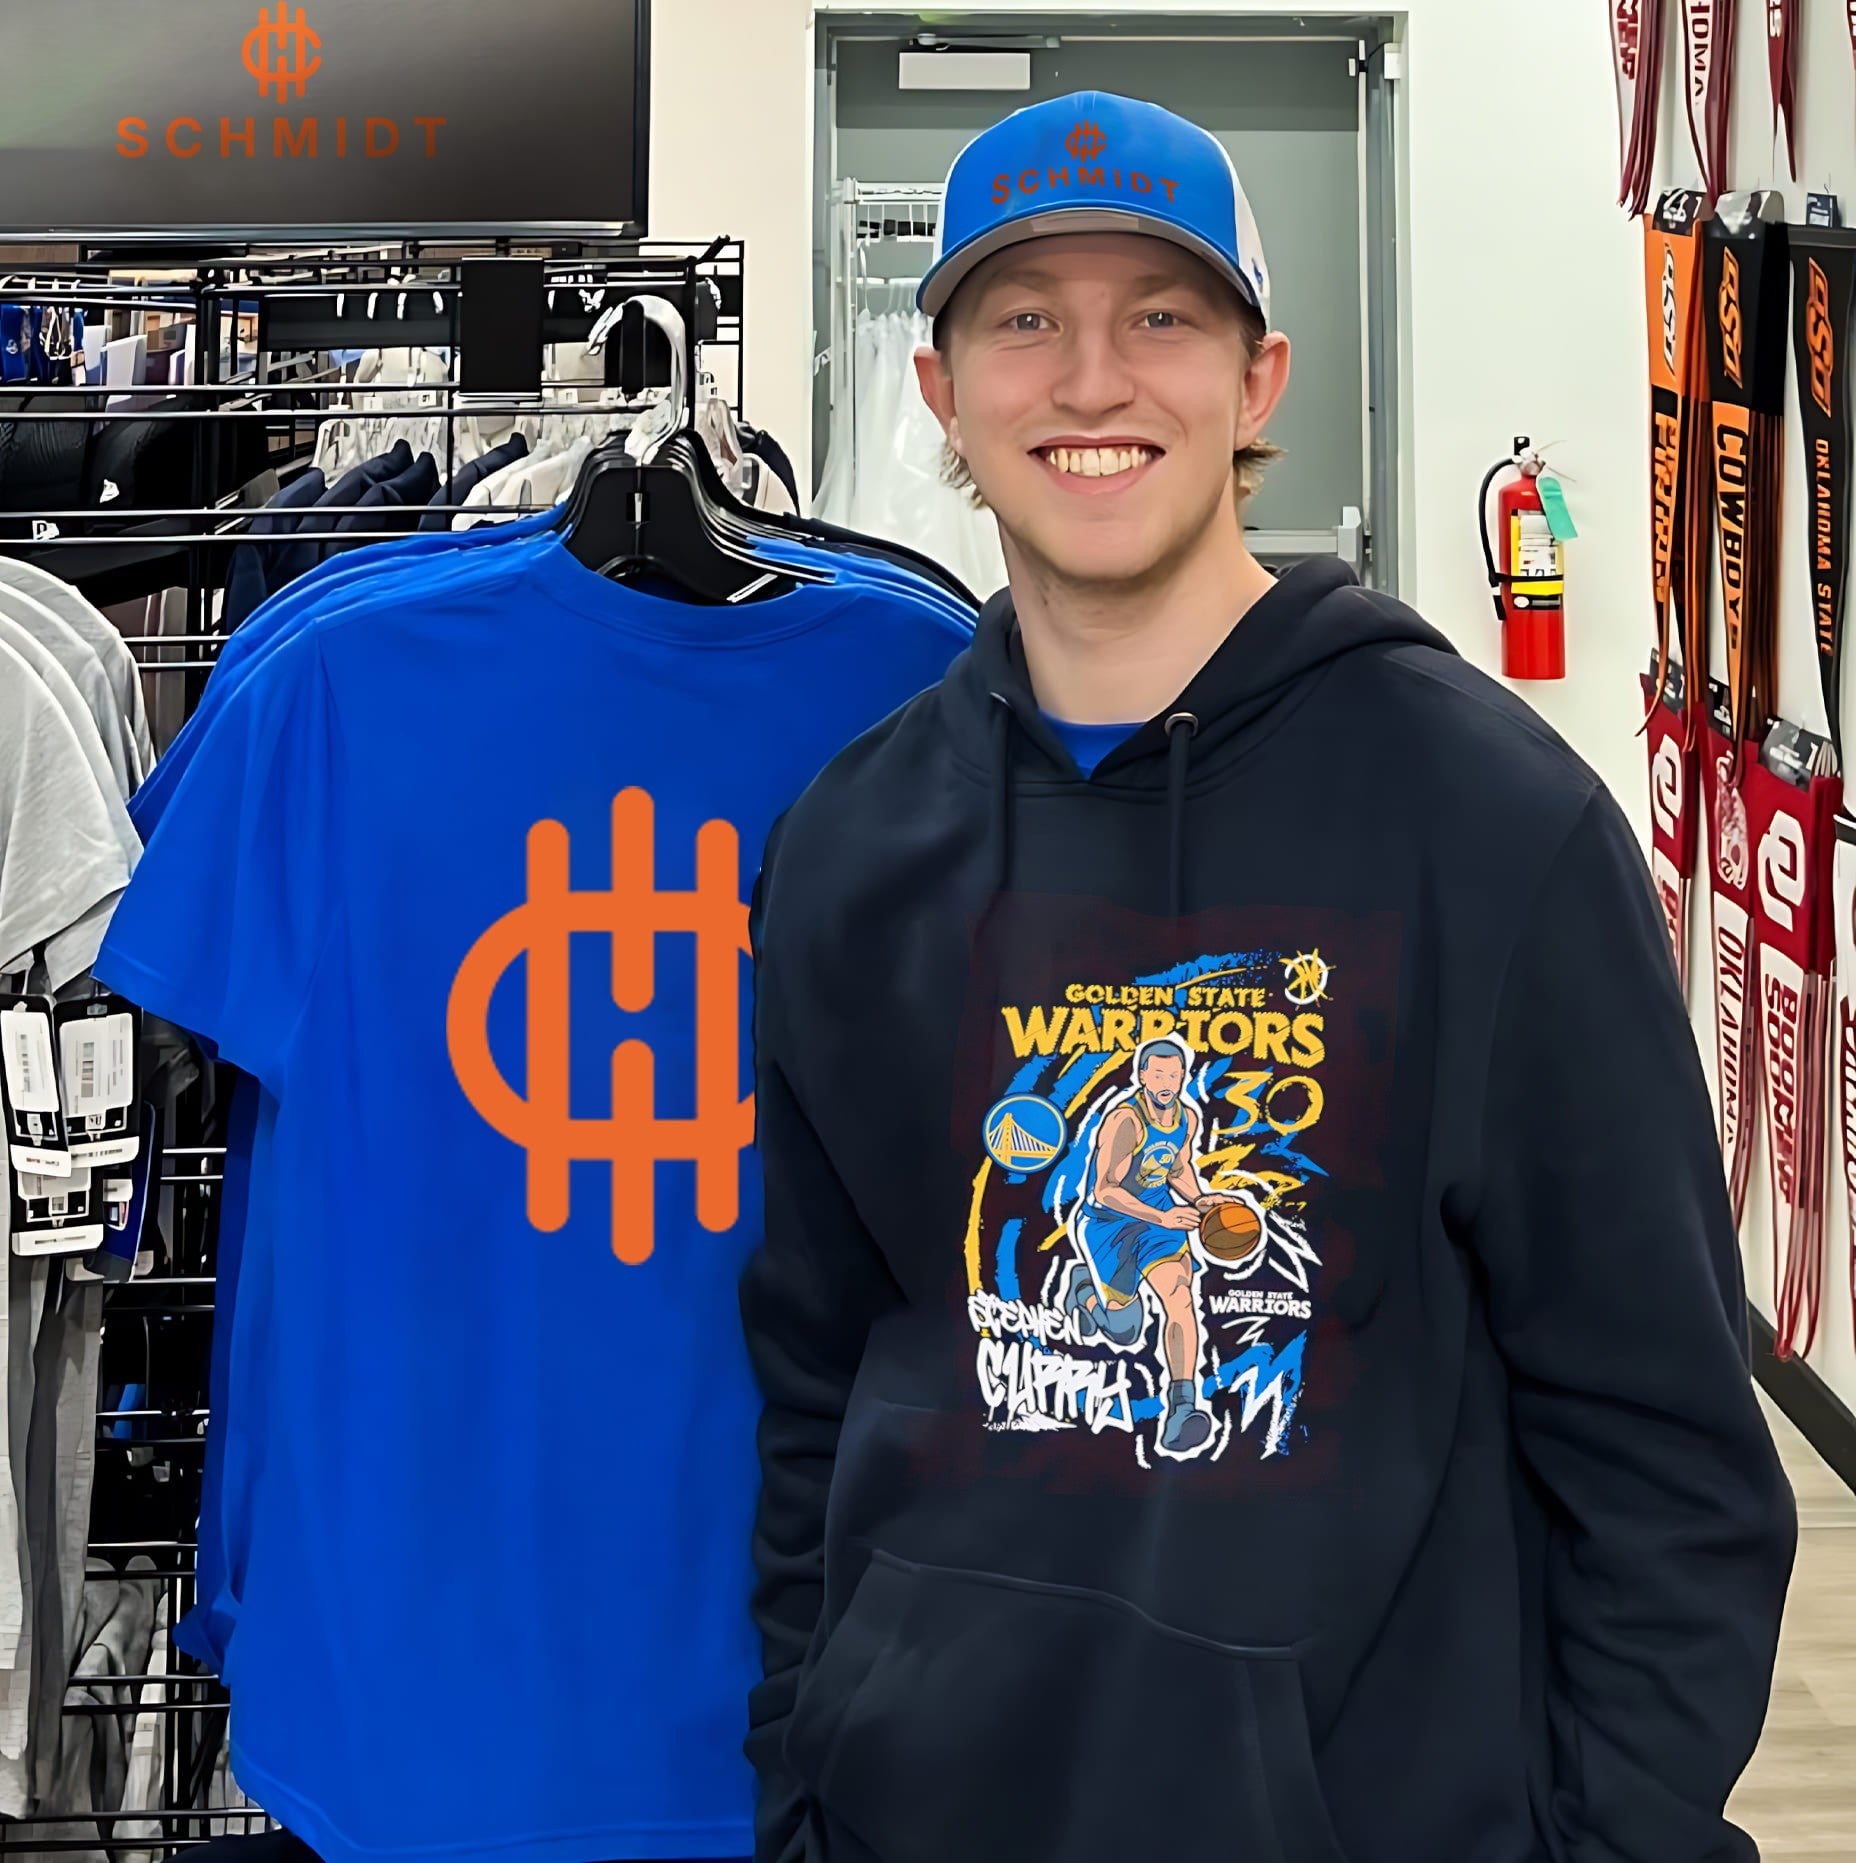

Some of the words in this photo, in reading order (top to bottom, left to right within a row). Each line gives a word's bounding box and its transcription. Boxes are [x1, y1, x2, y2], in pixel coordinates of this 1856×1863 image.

[115, 116, 447, 158] SCHMIDT
[991, 166, 1179, 204] SCHMIDT
[1065, 984, 1174, 1006] GOLDEN
[1187, 985, 1266, 1008] STATE
[1001, 1006, 1325, 1069] WARRIORS
[1718, 926, 1744, 1144] OKLAHOMA
[1212, 1070, 1324, 1135] 30
[1208, 1295, 1312, 1320] WARRIORS
[1228, 1289, 1264, 1299] GOLDEN
[1267, 1291, 1294, 1300] STATE
[976, 1337, 1134, 1435] CURRY
